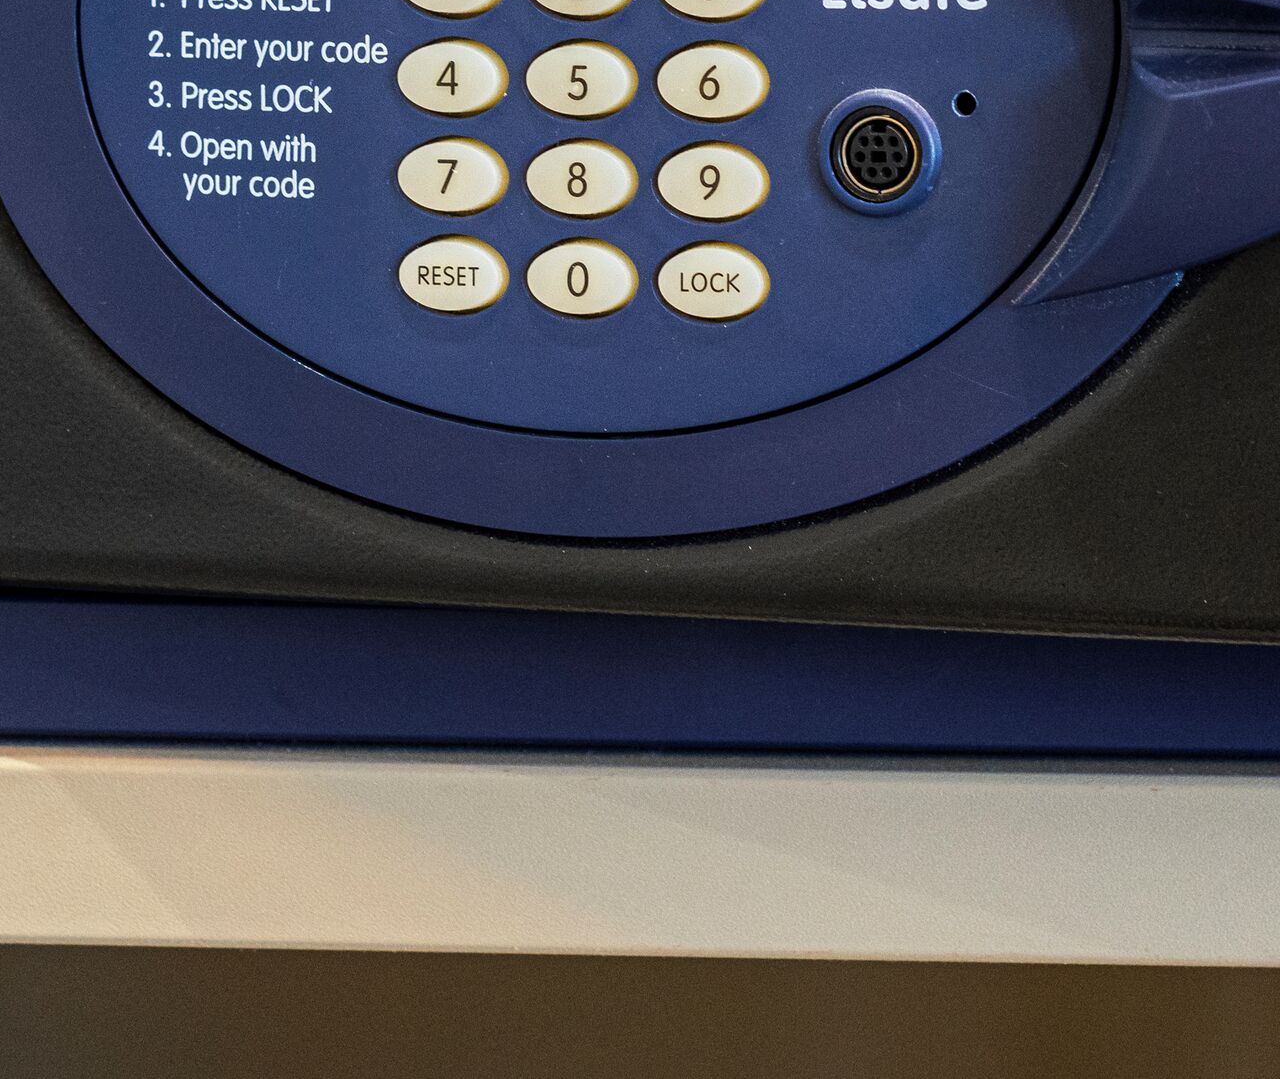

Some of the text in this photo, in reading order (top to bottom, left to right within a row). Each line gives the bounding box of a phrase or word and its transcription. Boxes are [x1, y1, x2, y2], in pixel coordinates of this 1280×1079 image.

[148, 29, 389, 68] 2. Enter your code
[435, 60, 459, 96] 4
[567, 64, 588, 101] 5
[698, 64, 720, 101] 6
[148, 80, 333, 114] 3. Press LOCK
[147, 129, 317, 167] 4. Open with
[182, 169, 315, 201] your code
[436, 158, 458, 195] 7
[567, 161, 588, 198] 8
[699, 164, 721, 201] 9
[417, 265, 480, 287] RESET
[566, 261, 589, 298] 0
[680, 272, 741, 293] LOCK
